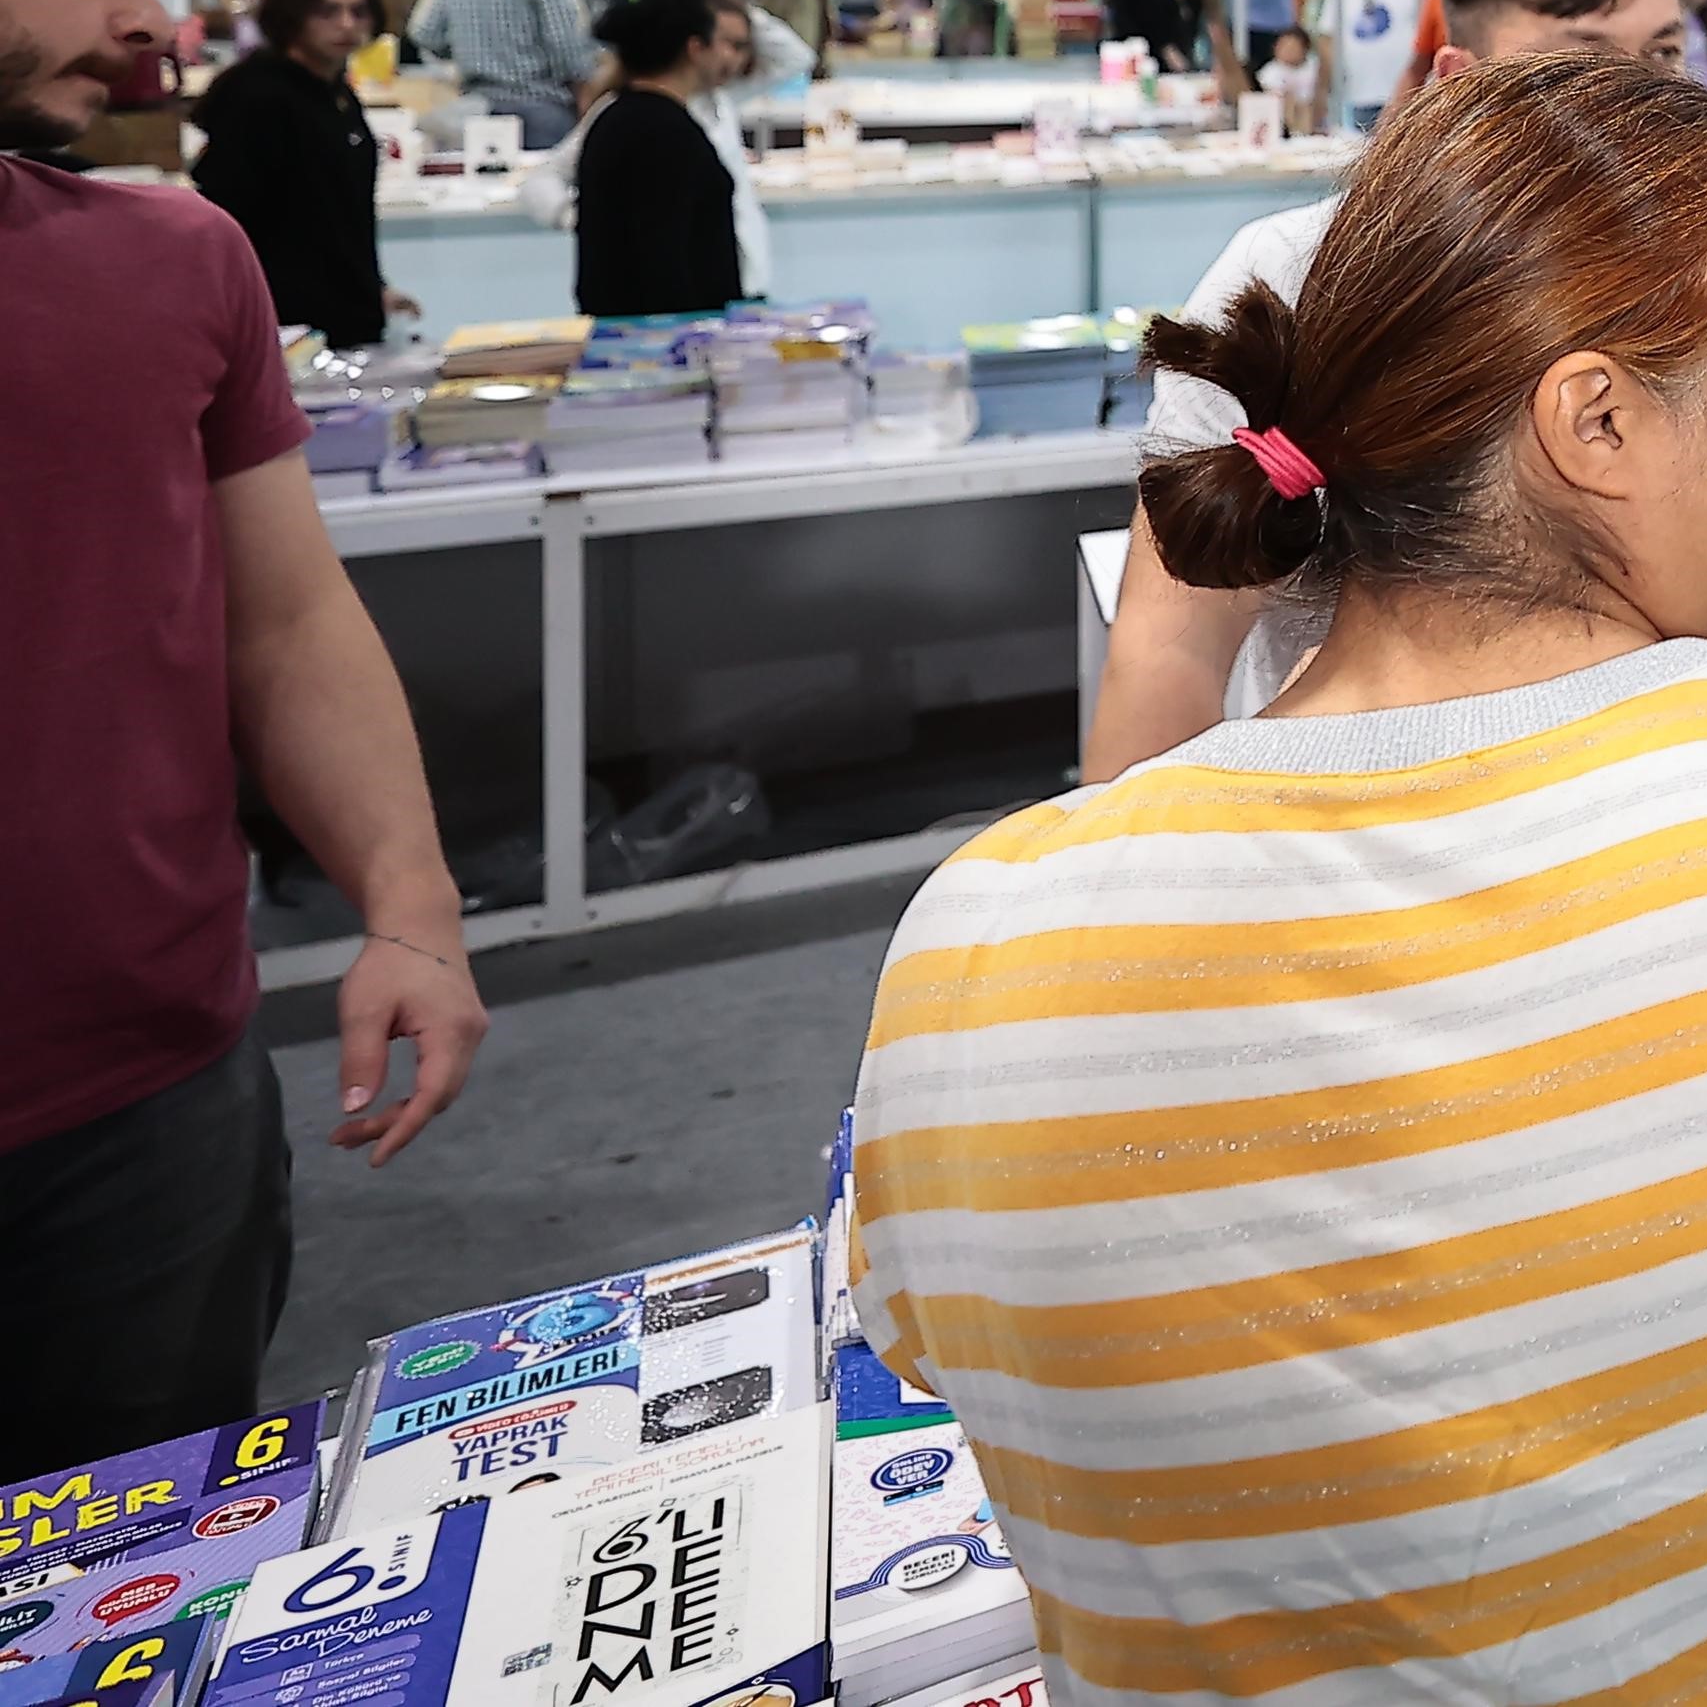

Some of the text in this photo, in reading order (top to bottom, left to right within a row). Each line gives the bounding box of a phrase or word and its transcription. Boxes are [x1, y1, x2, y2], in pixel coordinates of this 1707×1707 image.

[395, 1346, 621, 1433] FEN BİLİMLERİ
[452, 1413, 569, 1456] YAPRAK
[239, 1456, 300, 1480] SINIF
[452, 1431, 568, 1482] TEST
[889, 1459, 936, 1480] ÖDEV
[896, 1471, 929, 1486] VER
[388, 1533, 413, 1573] SINIF
[239, 1605, 377, 1664] Sarmal
[308, 1608, 433, 1658] Deneme
[318, 1657, 407, 1690] Sosyal Bilgiler
[324, 1653, 365, 1671] Türkçe
